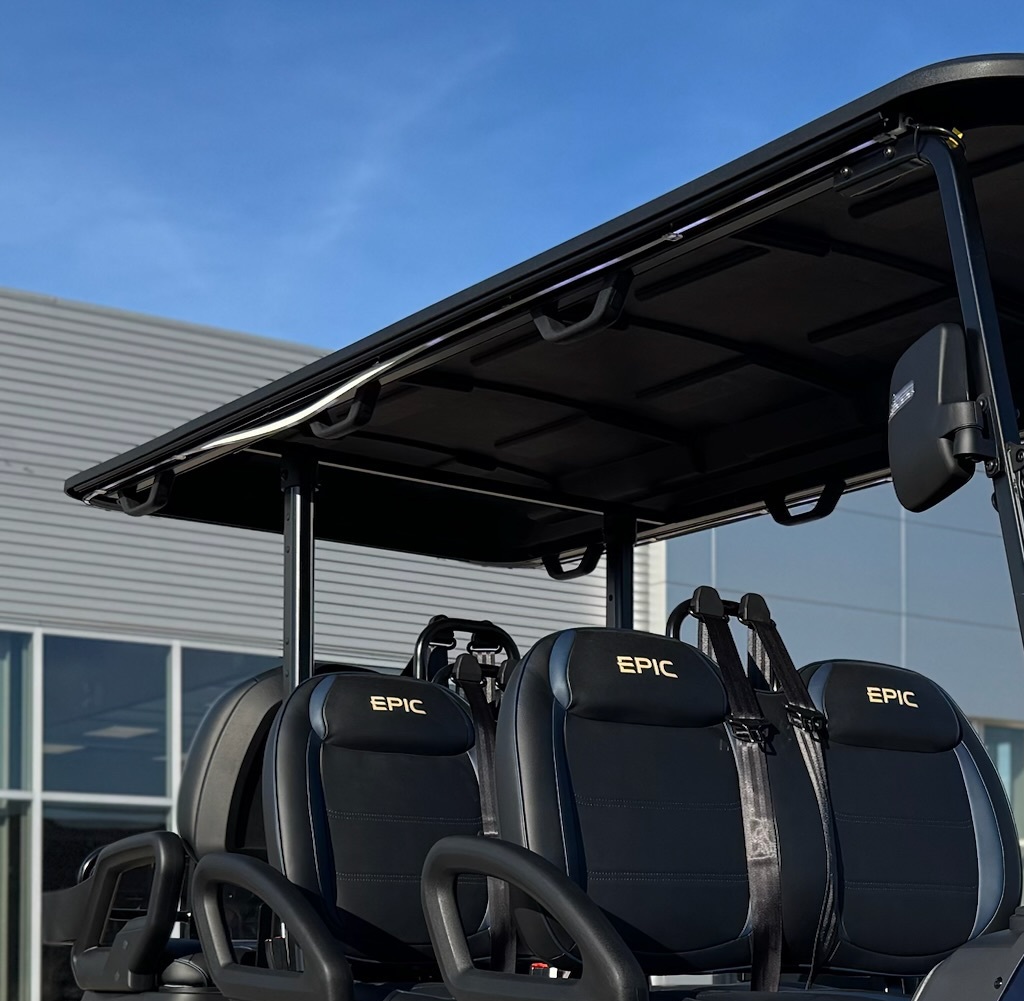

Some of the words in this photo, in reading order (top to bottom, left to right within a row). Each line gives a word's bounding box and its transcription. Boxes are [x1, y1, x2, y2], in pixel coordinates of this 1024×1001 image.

[616, 655, 678, 679] EPIC
[370, 695, 427, 714] EPIC
[867, 686, 919, 708] EPIC
